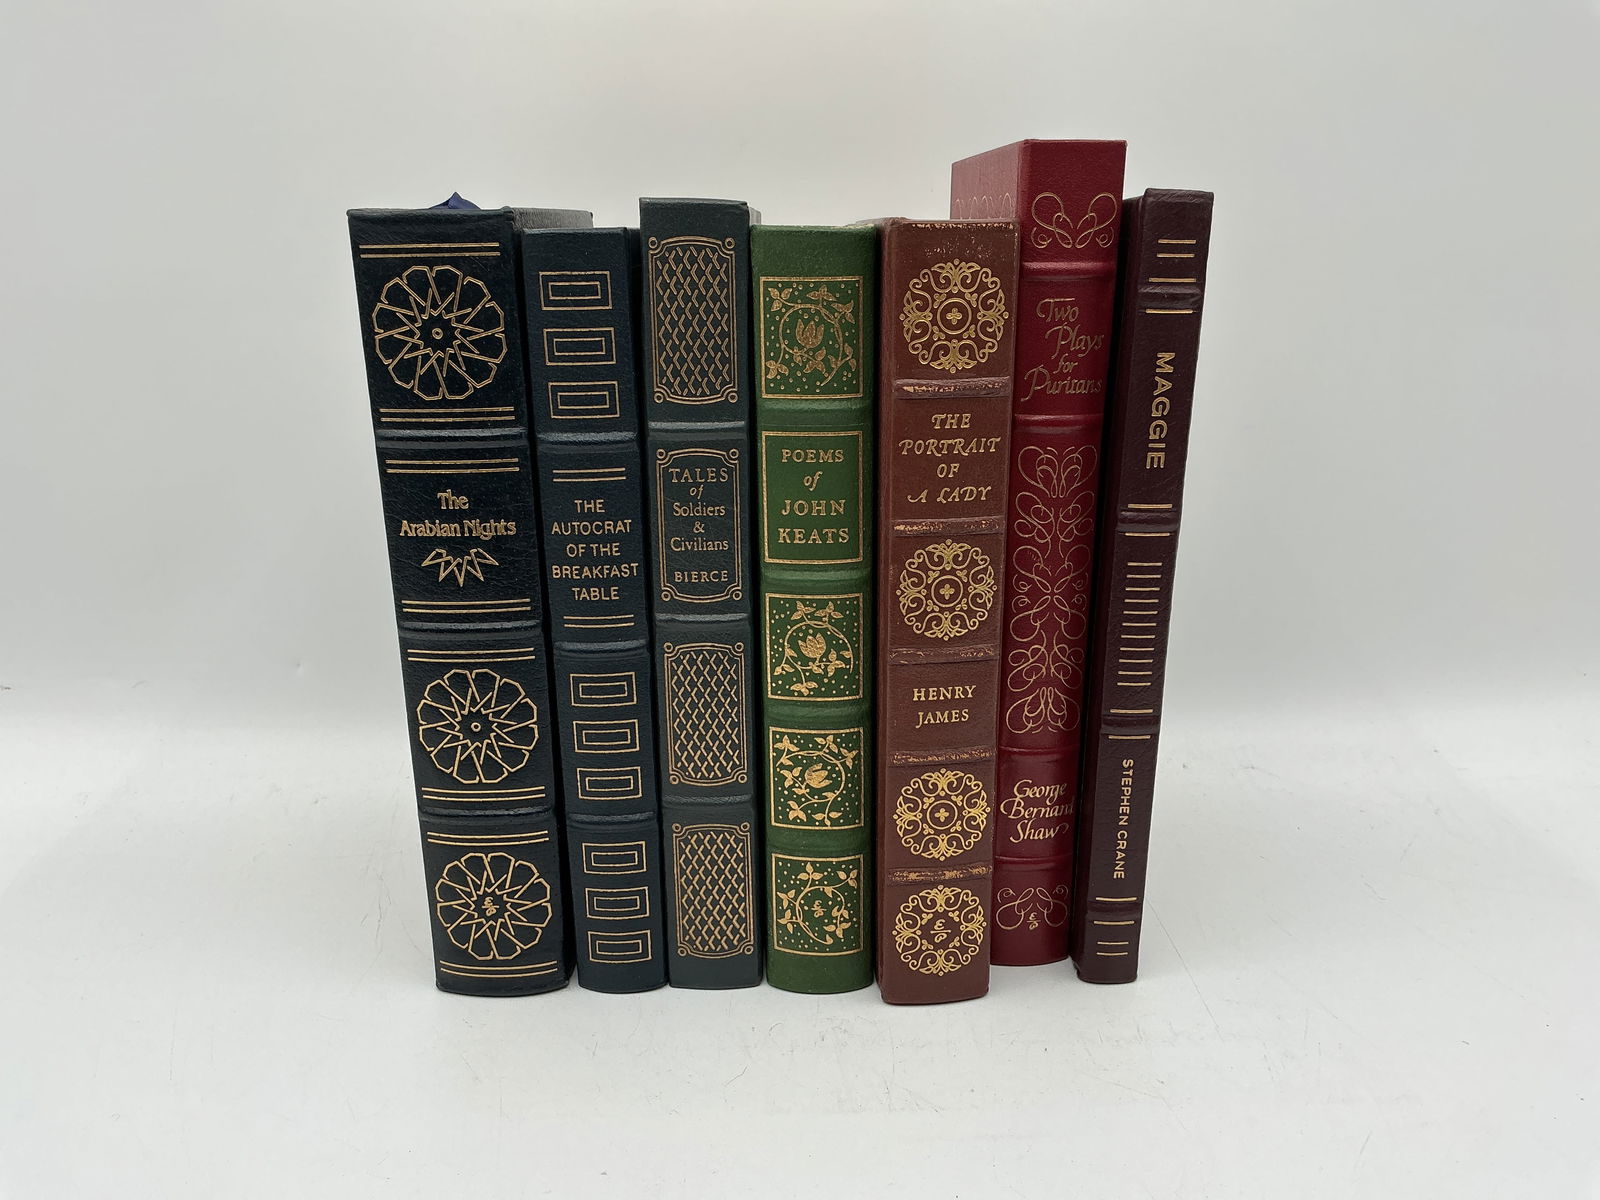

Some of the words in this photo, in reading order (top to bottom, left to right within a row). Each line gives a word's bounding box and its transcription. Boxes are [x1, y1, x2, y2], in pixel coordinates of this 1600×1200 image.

[1036, 297, 1079, 322] Two
[1045, 322, 1105, 360] Plays
[1053, 353, 1079, 375] for
[1020, 364, 1103, 403] Puritans
[1145, 352, 1176, 470] MAGGIE
[931, 413, 972, 430] THE
[781, 449, 845, 463] POEMS
[898, 437, 1002, 457] PORTRAIT
[668, 467, 729, 483] TALES
[936, 463, 960, 478] OF
[803, 471, 823, 492] of
[437, 489, 469, 510] The
[689, 484, 704, 500] of
[907, 488, 929, 503] A
[936, 485, 992, 504] LADY
[574, 499, 606, 513] THE
[672, 502, 726, 517] Soldiers
[781, 499, 846, 516] JOHN
[399, 519, 462, 537] Arabian
[464, 519, 517, 540] Nights
[551, 519, 632, 536] AUTOCRAT
[692, 520, 705, 534] &
[777, 527, 850, 545] KEATS
[566, 543, 587, 557] OF
[590, 542, 621, 557] THE
[670, 536, 729, 551] Civilians
[552, 562, 640, 580] BREAKFAST
[674, 570, 729, 583] BIERCE
[571, 586, 620, 601] TABLE
[912, 685, 977, 702] HENRY
[915, 708, 970, 729] JAMES
[1013, 779, 1068, 806] George
[1118, 758, 1135, 826] STEPHEN
[1009, 817, 1070, 844] Shaw
[1113, 829, 1129, 879] CRANE
